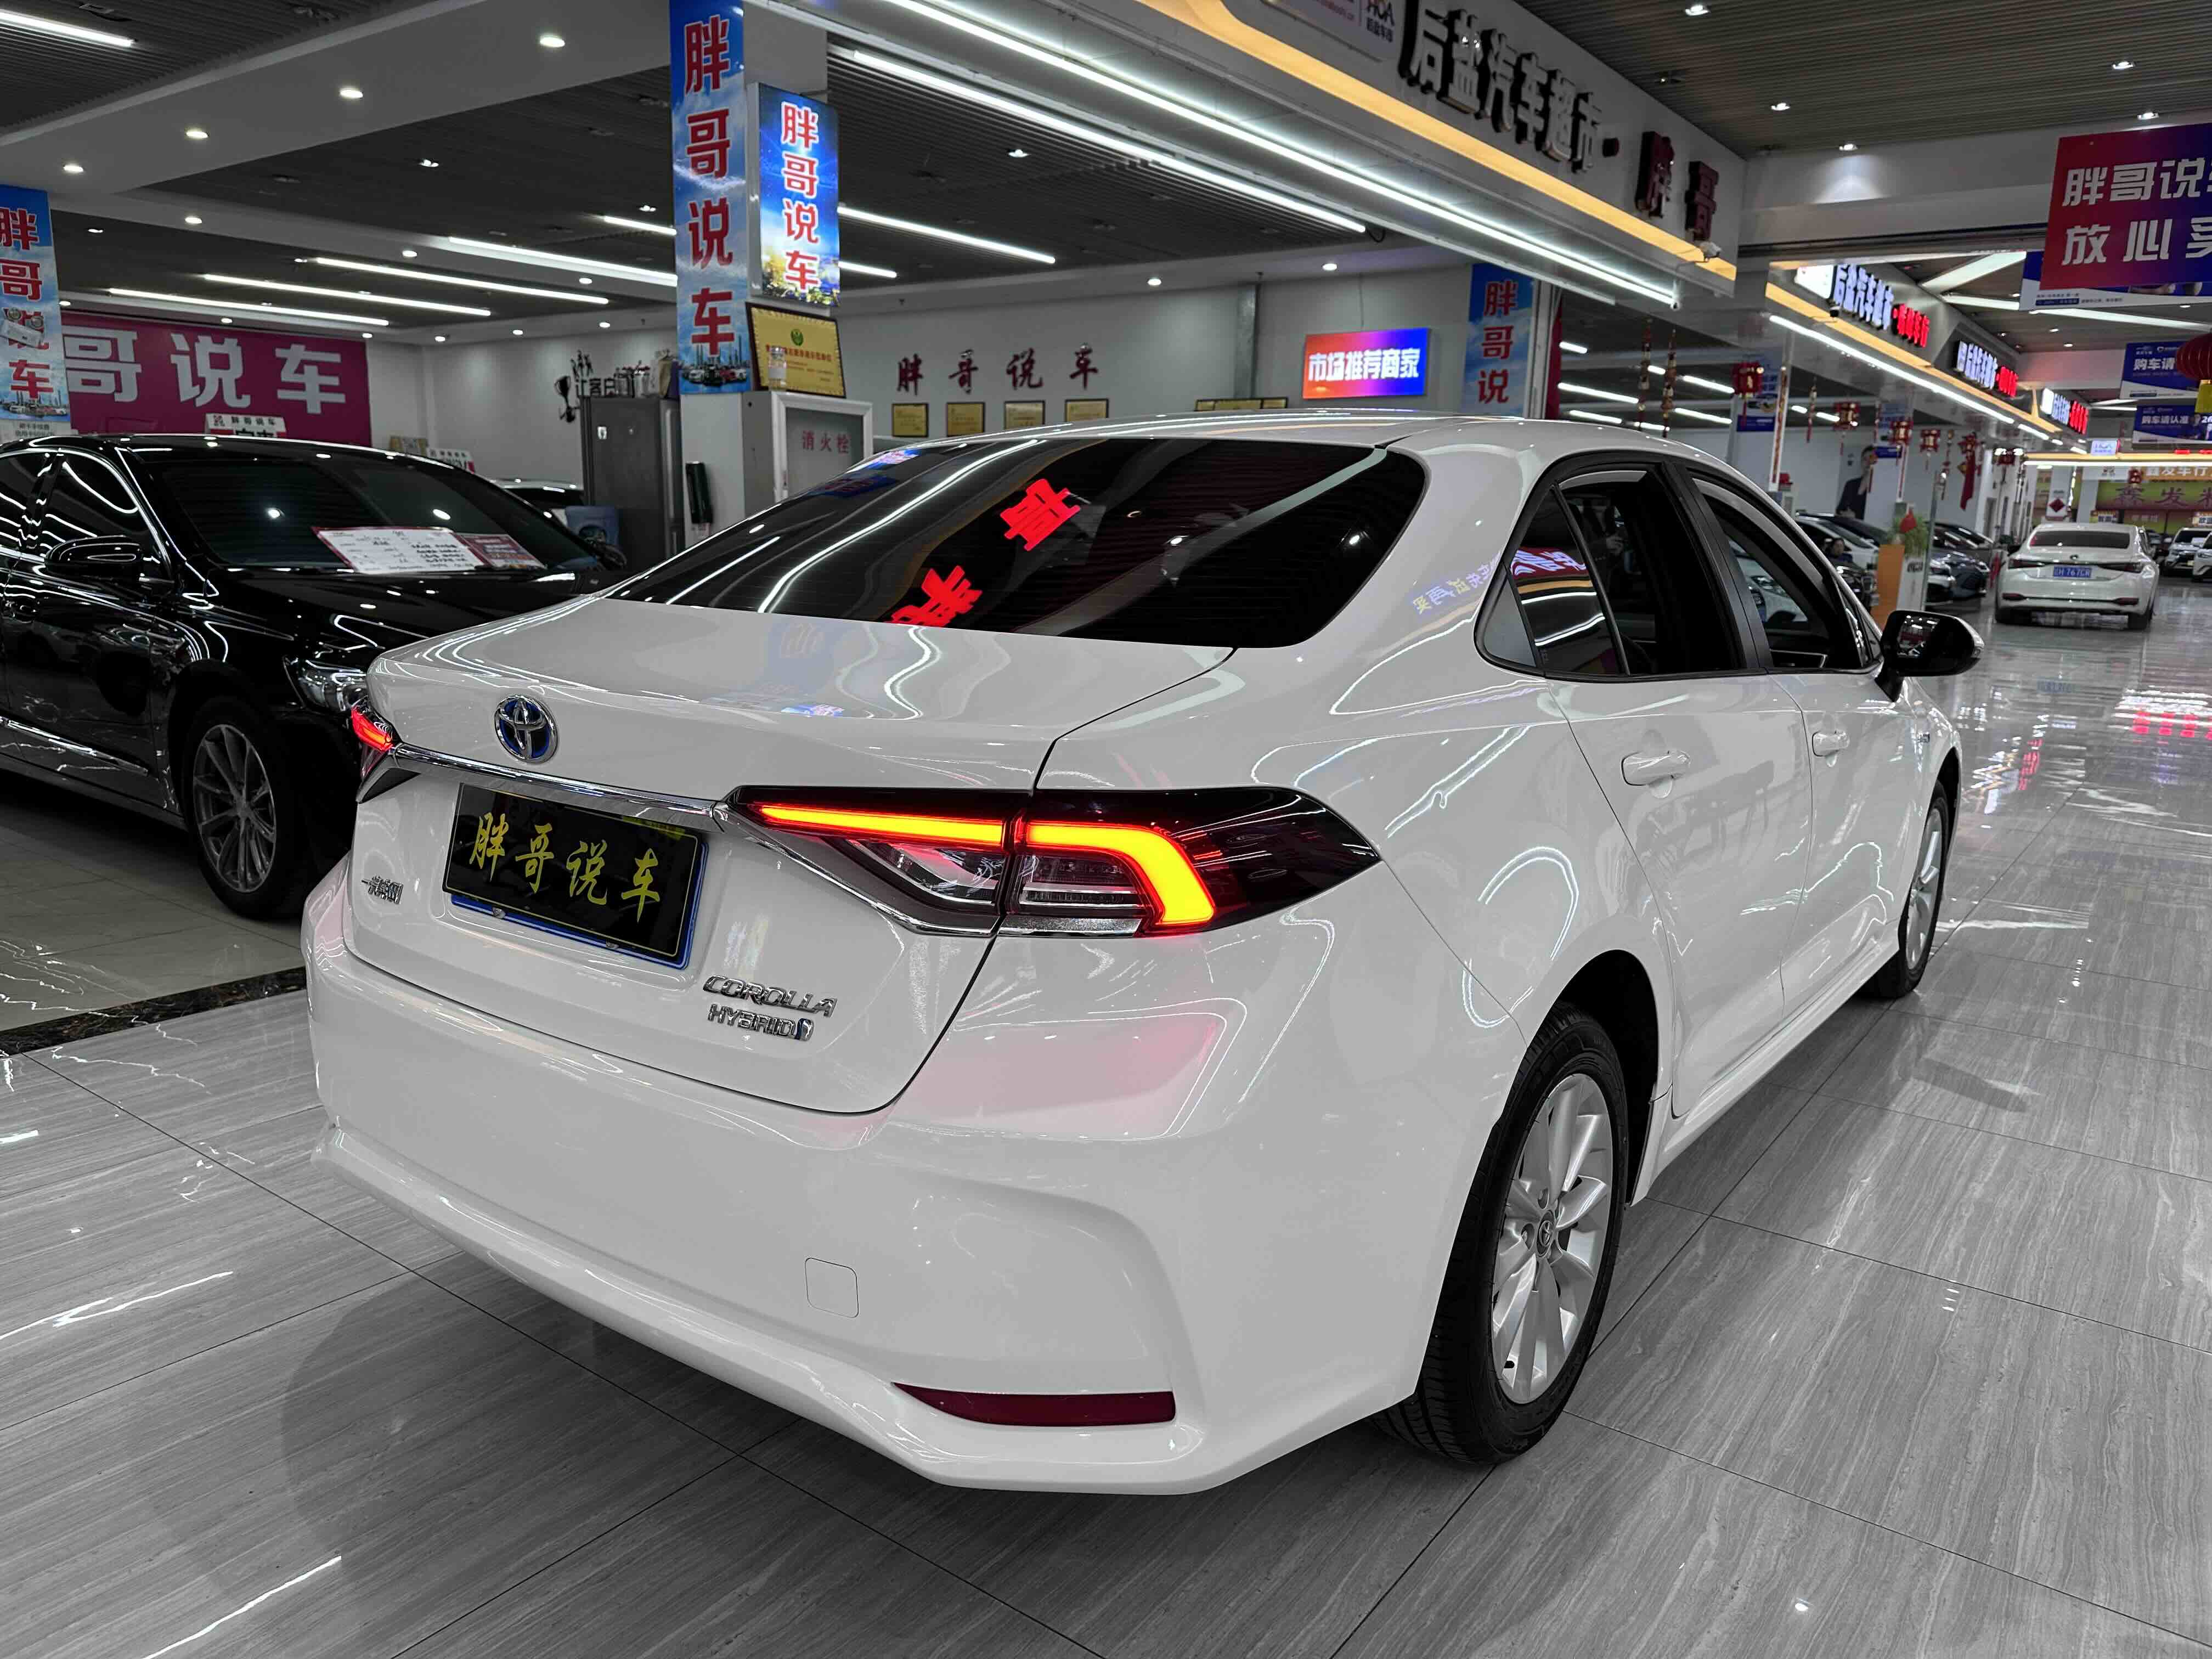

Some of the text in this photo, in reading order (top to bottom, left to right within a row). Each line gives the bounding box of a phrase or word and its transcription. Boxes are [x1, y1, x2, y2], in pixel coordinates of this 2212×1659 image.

[684, 15, 735, 358] 胖哥说车
[781, 101, 820, 292] 胖哥说车
[2062, 157, 2212, 207] 胖哥说
[897, 342, 1098, 396] 胖哥说车
[1308, 347, 1421, 382] 市场推荐商家
[1477, 279, 1519, 405] 胖哥说
[63, 331, 346, 414] 哥说车
[802, 430, 850, 456] 消火栓
[469, 812, 660, 923] 胖哥说车
[702, 975, 837, 1017] COROLLA
[707, 1003, 797, 1039] HYBRID
